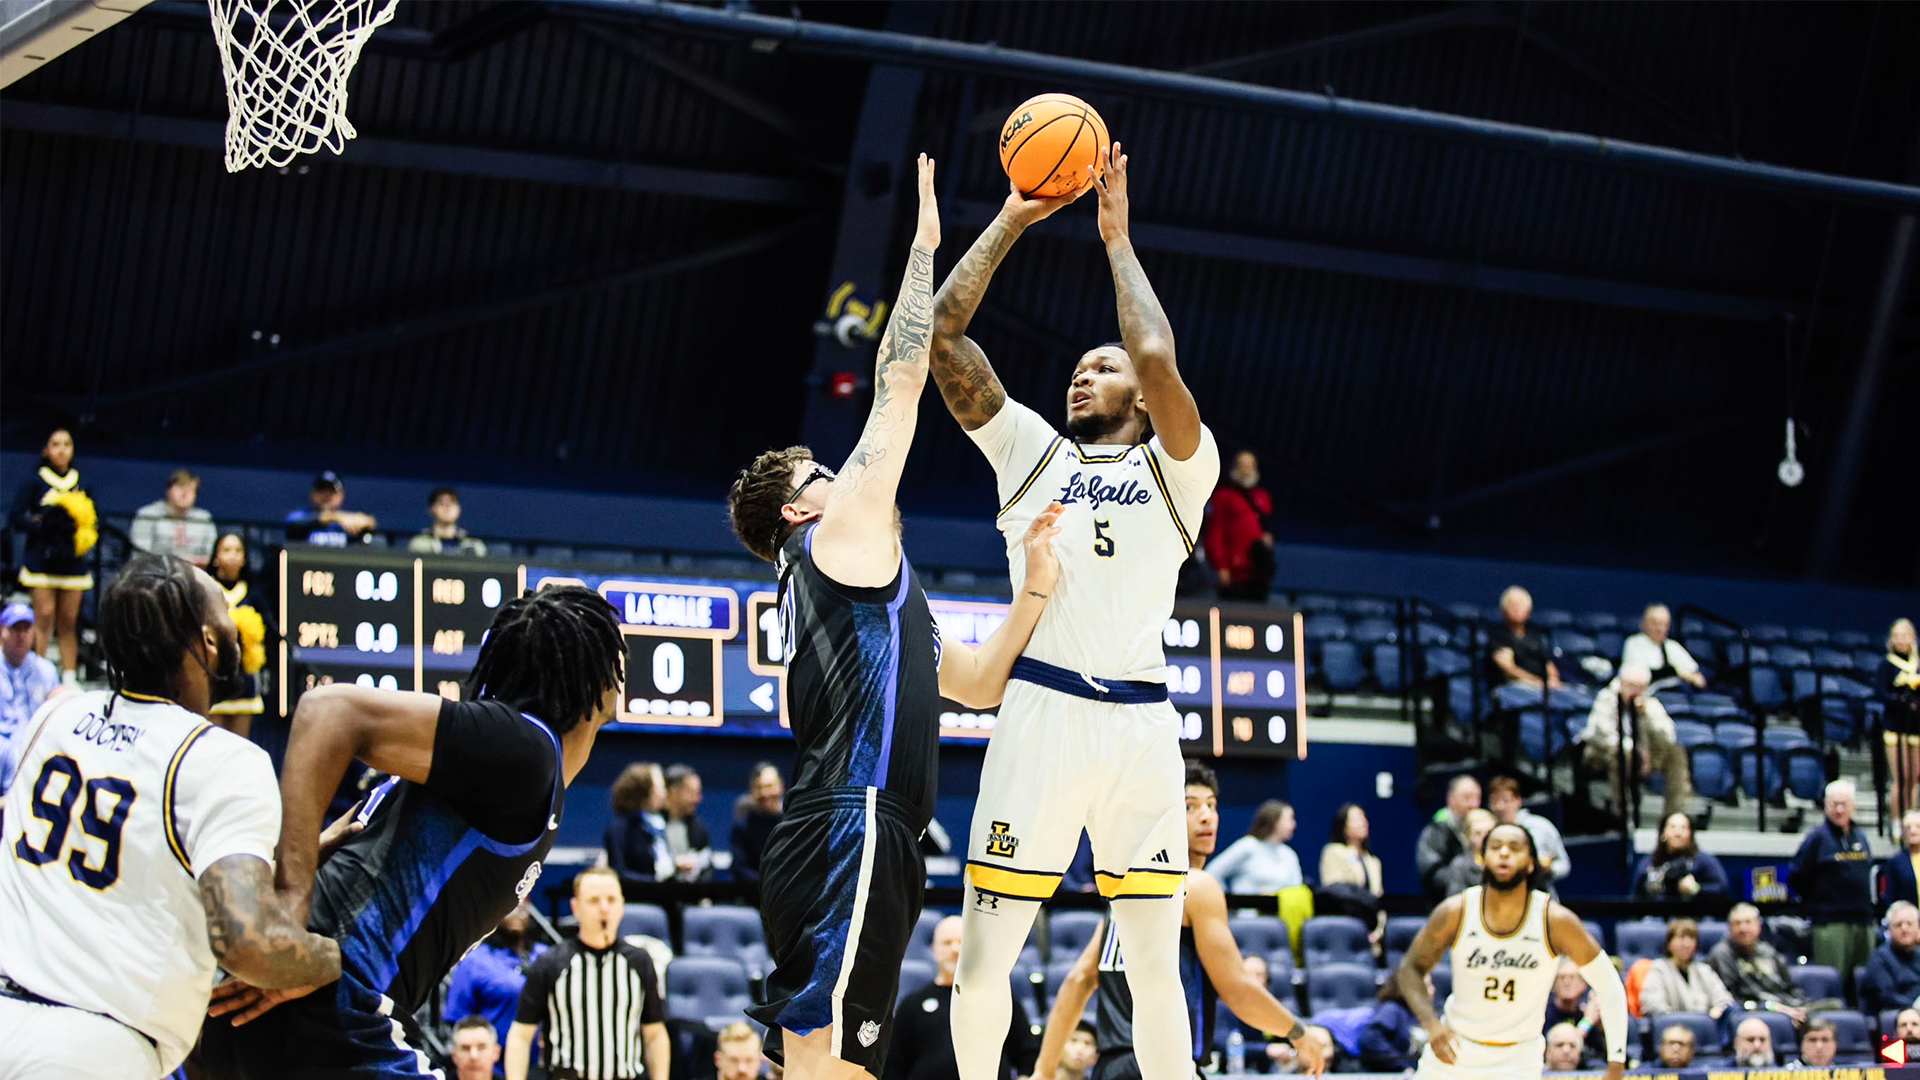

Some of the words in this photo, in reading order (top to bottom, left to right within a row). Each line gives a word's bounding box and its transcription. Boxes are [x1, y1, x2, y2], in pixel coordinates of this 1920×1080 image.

[1001, 111, 1033, 150] NCAA
[1093, 518, 1116, 559] 5
[355, 570, 398, 602] 0.0
[481, 578, 502, 608] 0
[355, 621, 398, 653] 0.0
[1265, 624, 1284, 652] 0
[652, 641, 684, 694] 0
[1266, 670, 1285, 699] 0
[1268, 715, 1287, 744] 0
[15, 752, 138, 894] 99
[1484, 976, 1516, 1002] 24
